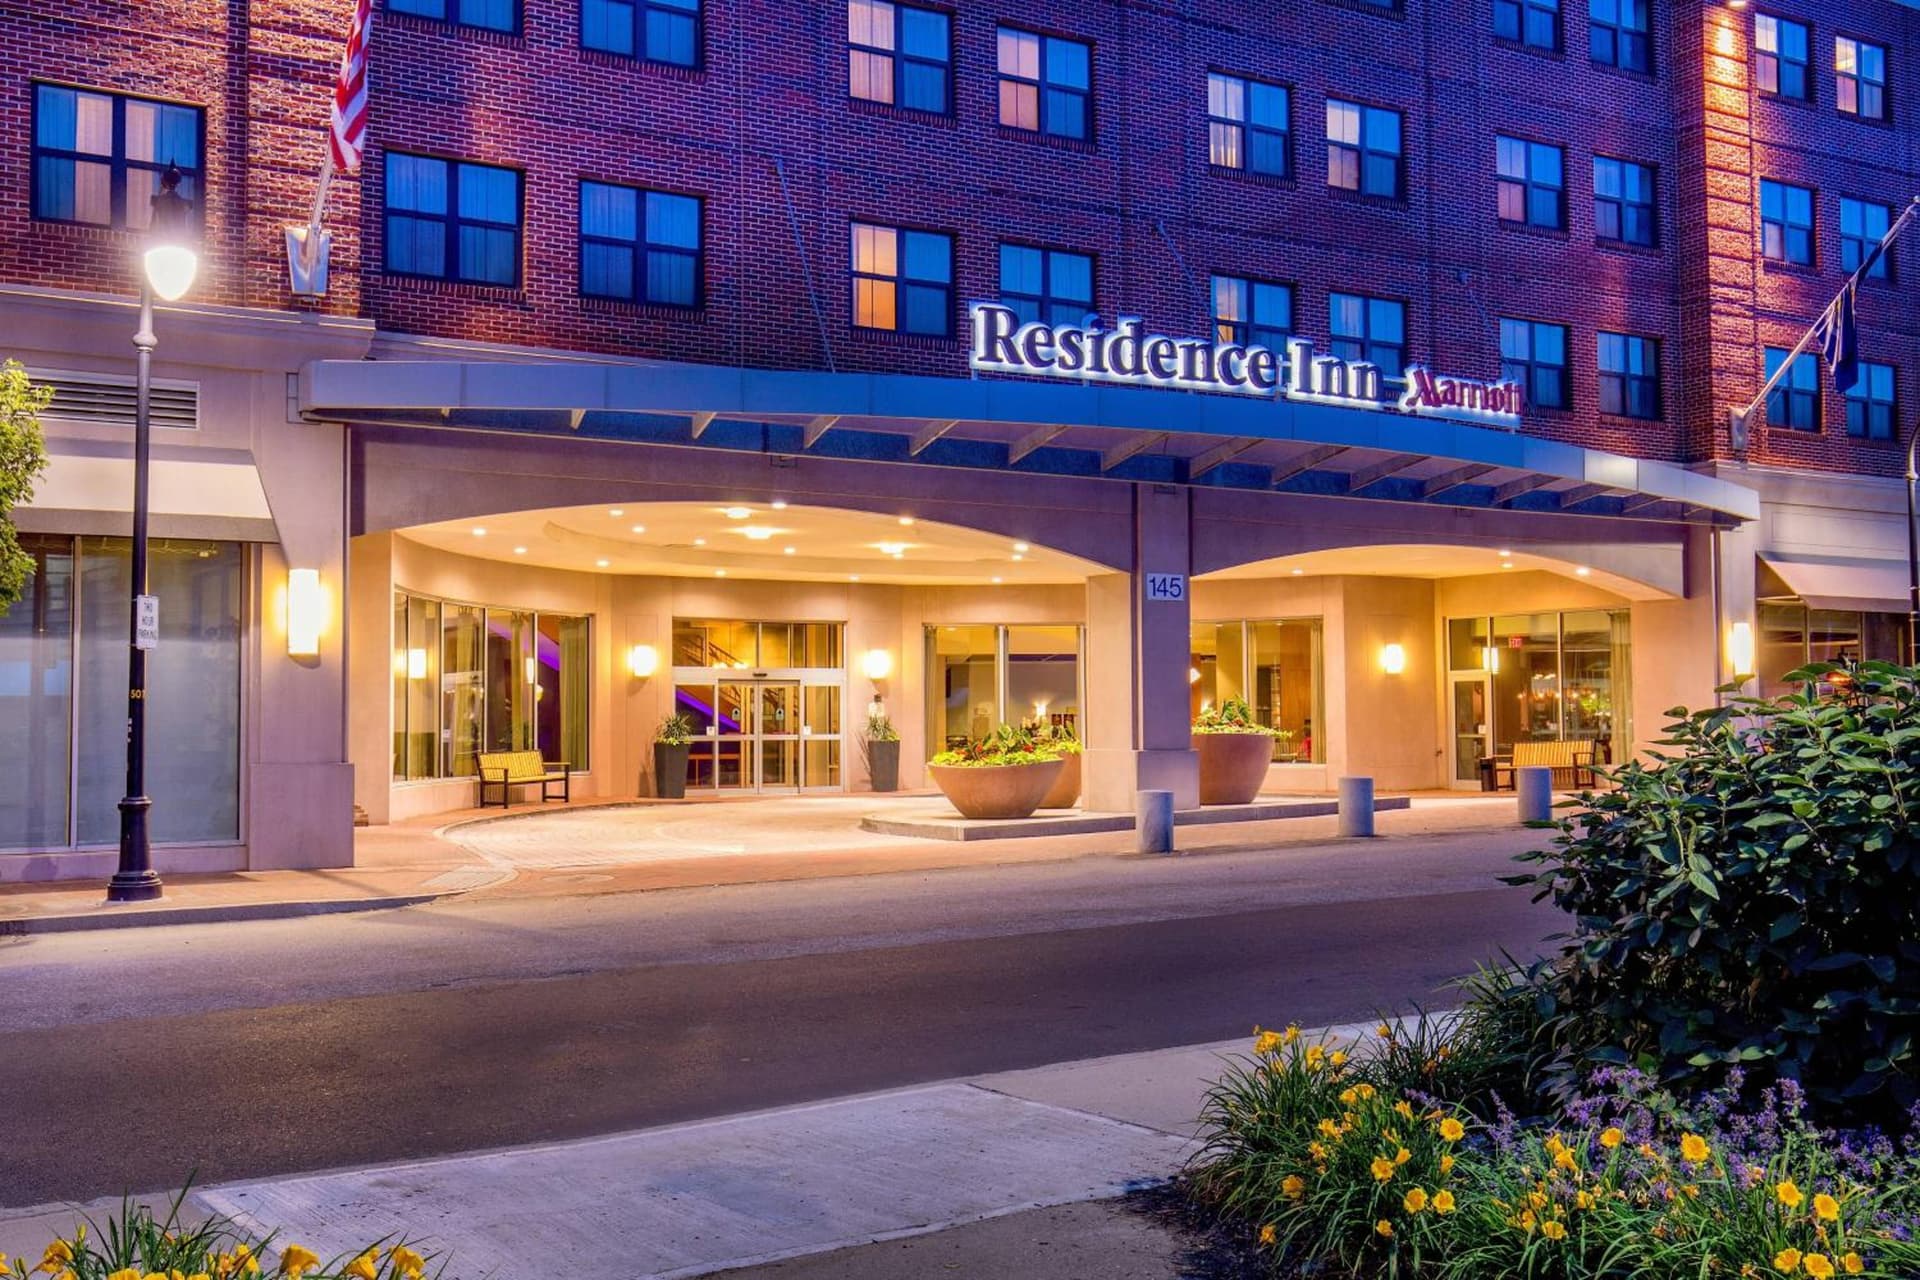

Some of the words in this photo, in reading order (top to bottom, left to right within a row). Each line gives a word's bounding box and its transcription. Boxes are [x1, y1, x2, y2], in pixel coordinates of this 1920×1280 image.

[977, 305, 1277, 389] Residence
[1295, 342, 1384, 401] Inn
[1405, 368, 1523, 415] Marriott
[1149, 576, 1182, 598] 145
